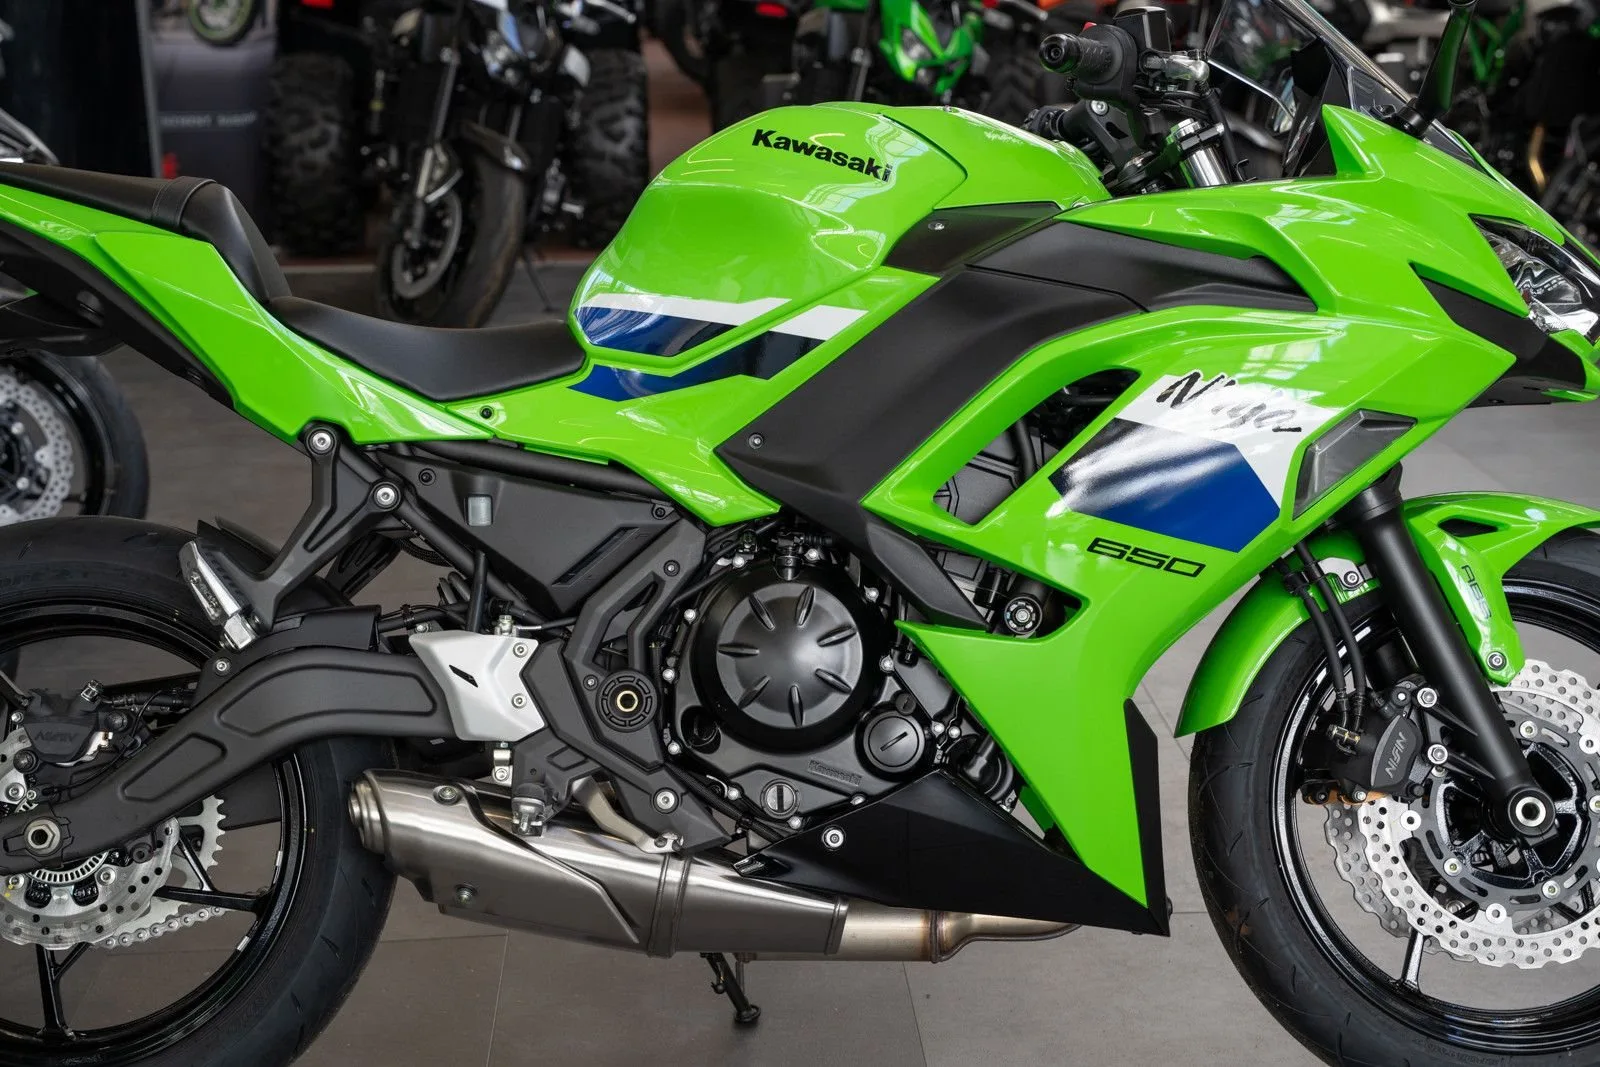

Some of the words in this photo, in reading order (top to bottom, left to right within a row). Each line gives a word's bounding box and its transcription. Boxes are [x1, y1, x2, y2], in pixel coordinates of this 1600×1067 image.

[752, 129, 893, 183] Kawasaki
[1086, 536, 1207, 578] 650
[1385, 731, 1408, 779] NISSIN
